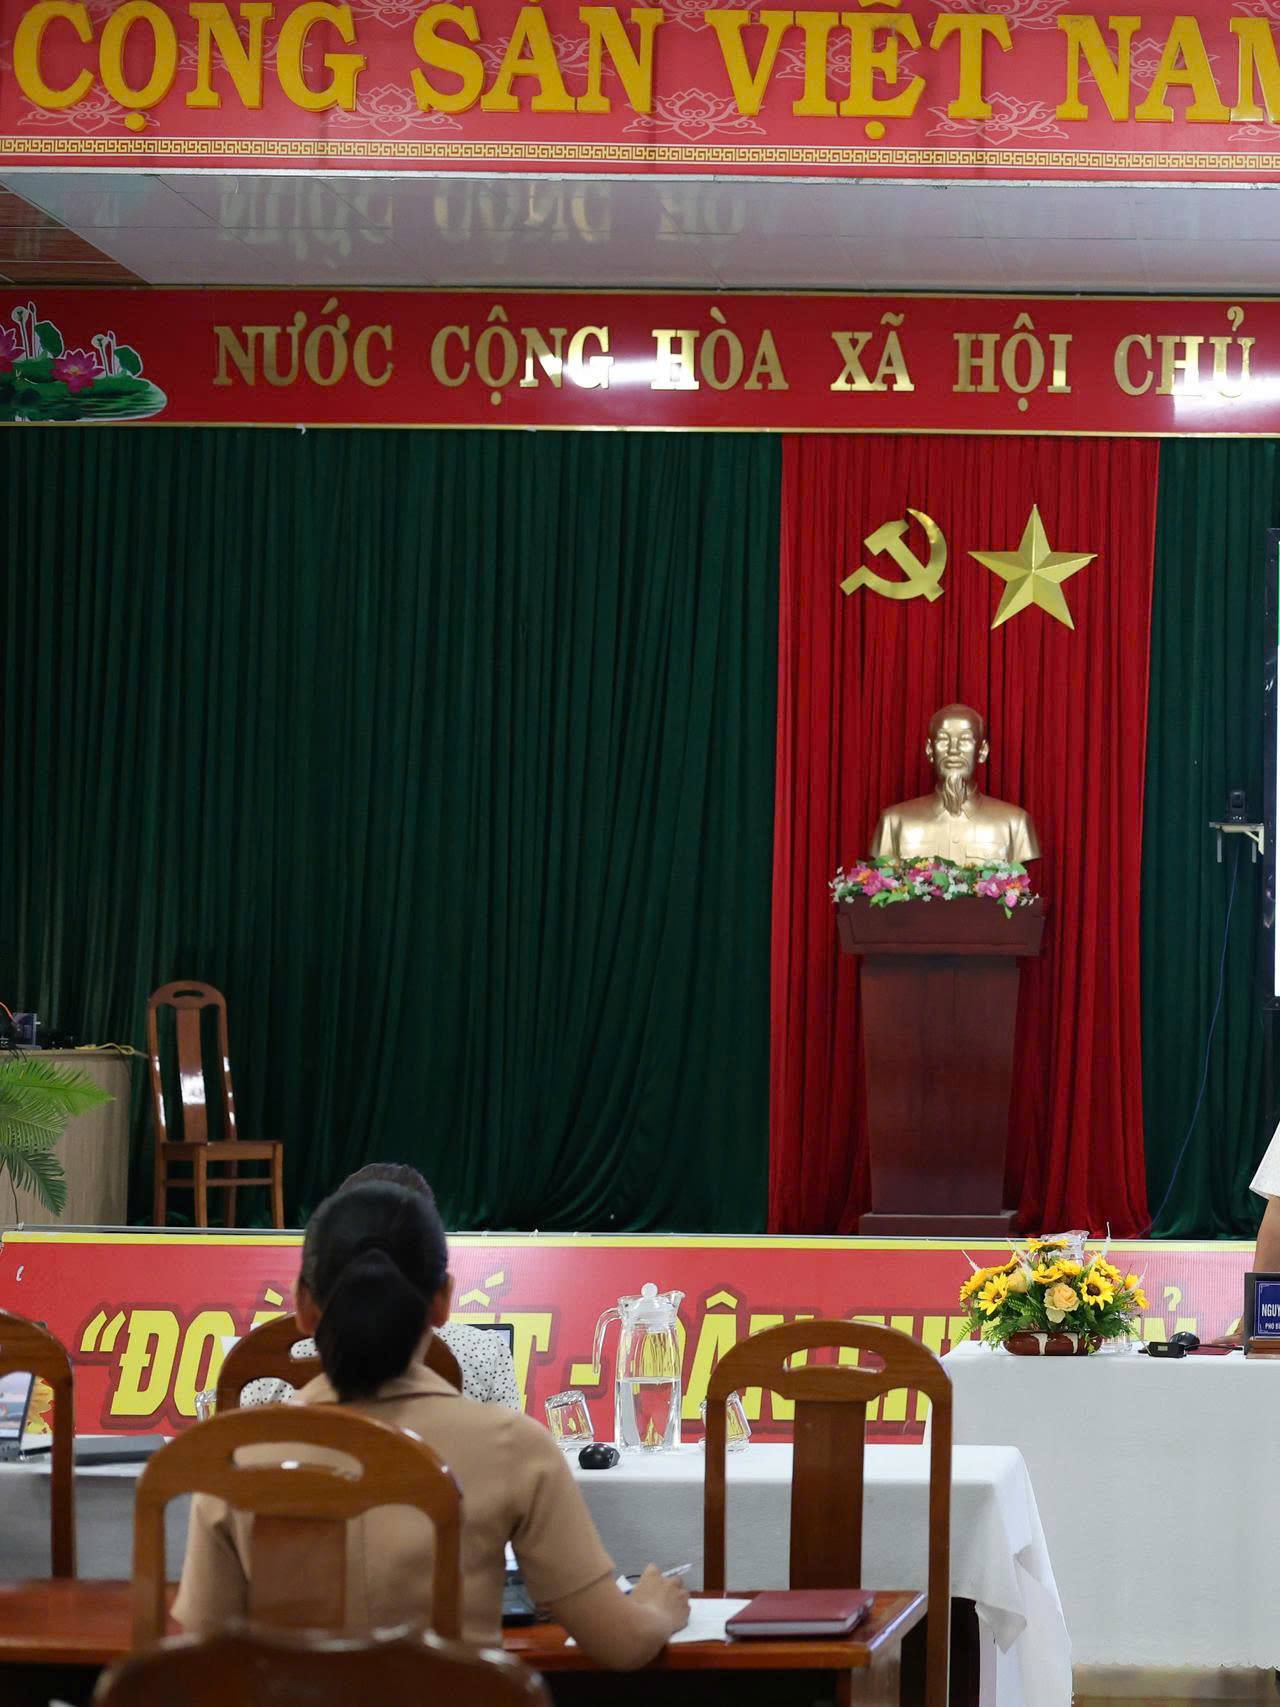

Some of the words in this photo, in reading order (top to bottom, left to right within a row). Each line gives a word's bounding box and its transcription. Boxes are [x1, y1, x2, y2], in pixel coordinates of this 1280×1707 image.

[703, 0, 1014, 140] VIỆT
[212, 297, 393, 389] NƯỚC
[430, 305, 614, 406] CỘNG
[650, 306, 789, 392] HÒA
[830, 313, 916, 393] XÃ
[953, 313, 1073, 412] HỘI
[1113, 306, 1256, 398] CHỦ
